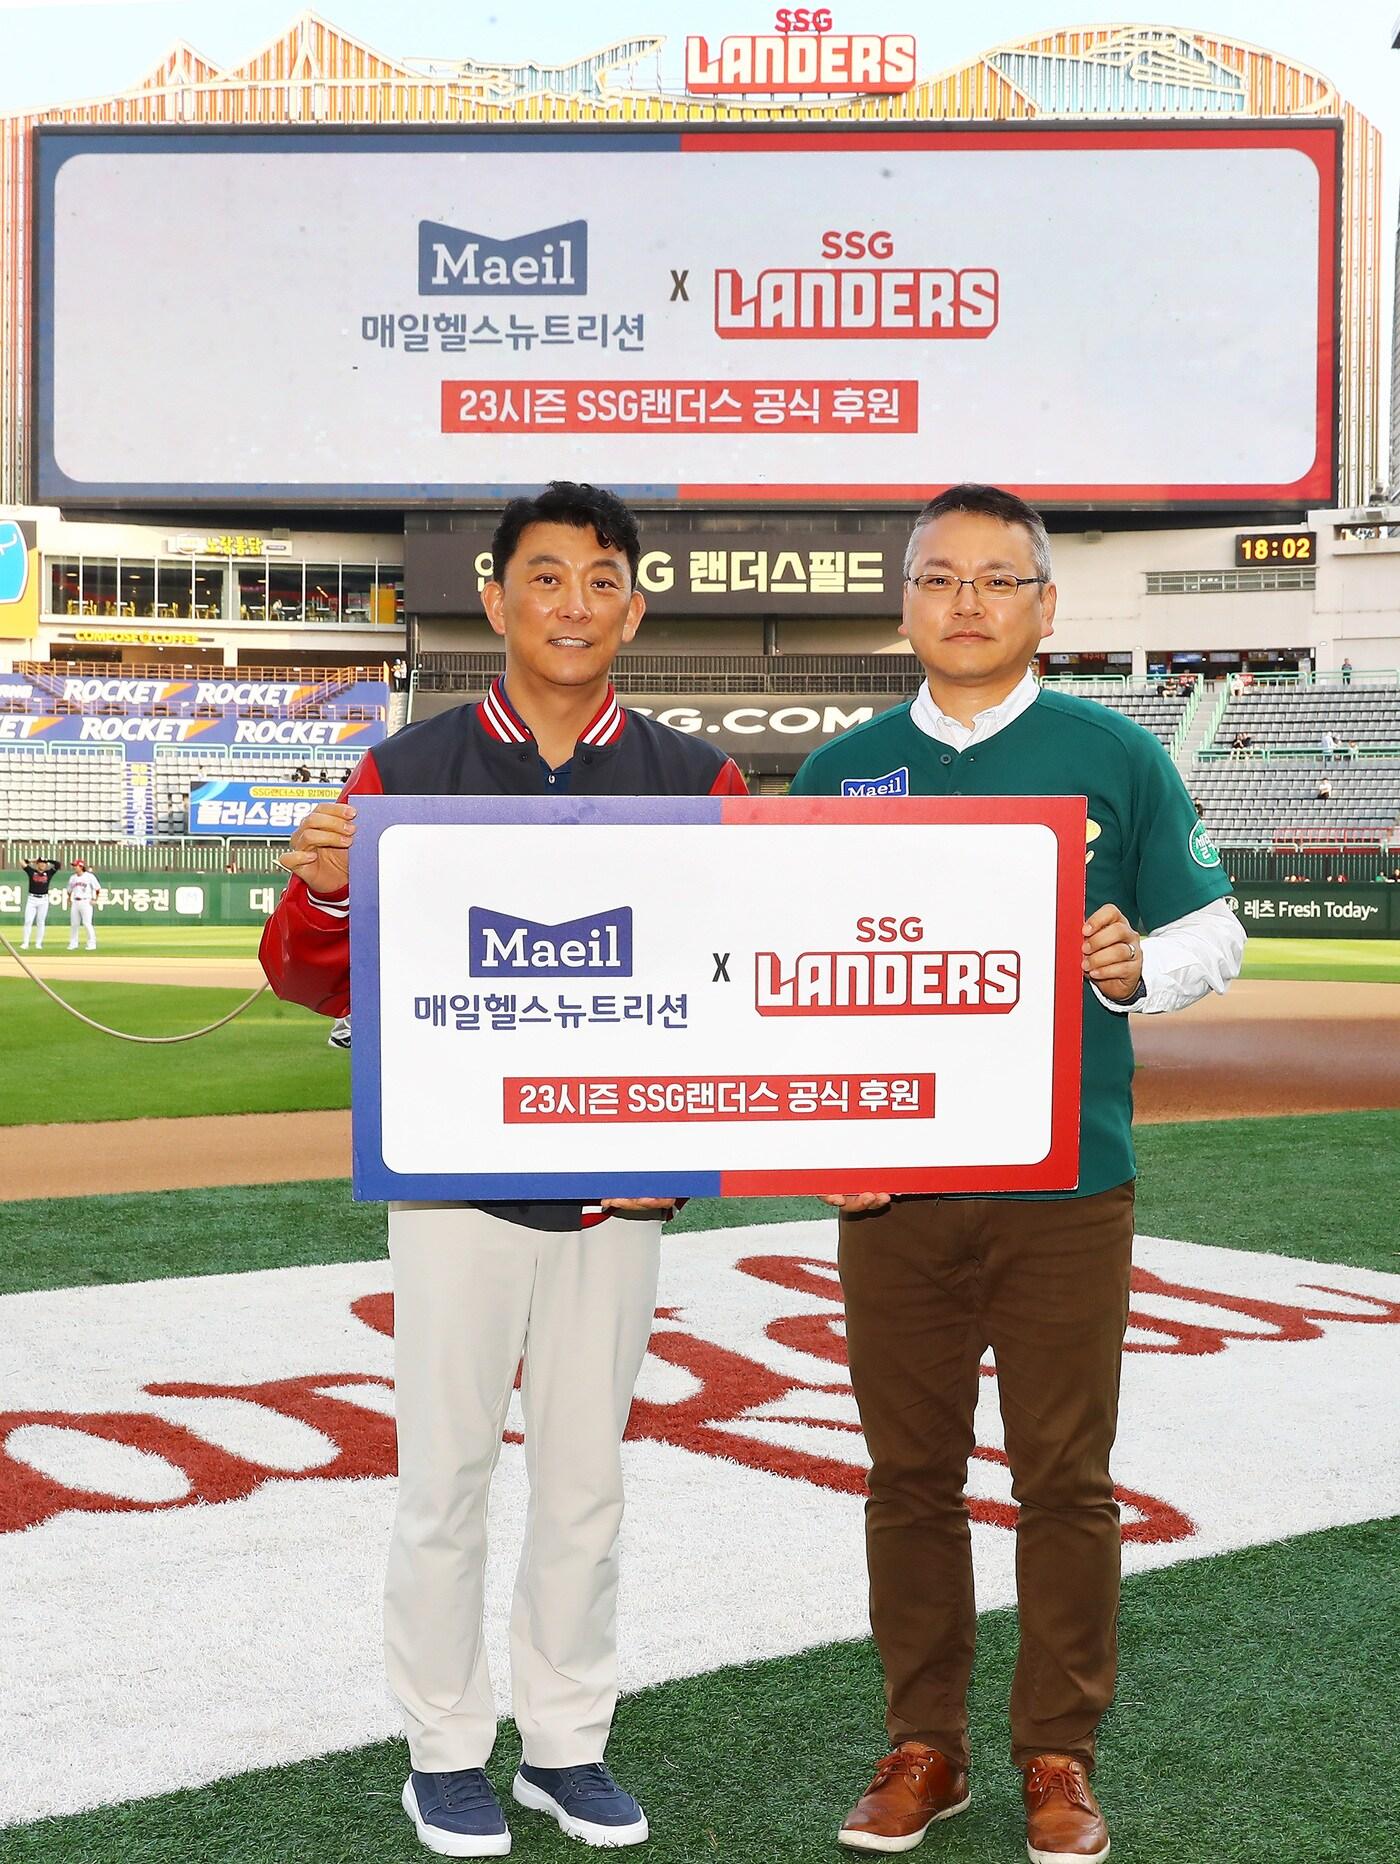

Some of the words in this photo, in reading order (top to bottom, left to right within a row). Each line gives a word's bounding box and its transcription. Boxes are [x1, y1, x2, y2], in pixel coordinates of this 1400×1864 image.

[774, 8, 833, 32] SSG
[686, 35, 916, 93] LANDERS
[821, 230, 894, 260] SSG
[431, 241, 575, 287] Maeil
[714, 267, 999, 339] LANDERS
[361, 312, 645, 353] 매일헬스뉴트리션
[459, 386, 567, 426] 23시즌
[577, 386, 743, 426] SSG랜더스
[752, 386, 821, 426] 공식
[832, 386, 901, 426] 후원
[1240, 536, 1311, 561] 18:02
[689, 550, 884, 594] 랜더스필드
[63, 679, 170, 703] ROCKET
[195, 683, 300, 706] ROCKET
[79, 717, 195, 742] ROCKET
[234, 720, 349, 745] ROCKET
[627, 706, 874, 735] G.COM
[848, 777, 902, 797] Maeil
[48, 887, 170, 912] 하투자증권
[1244, 899, 1275, 920] 레츠
[1279, 900, 1321, 919] Fresh
[1323, 901, 1379, 921] Today~
[856, 916, 924, 943] SSG
[480, 925, 622, 969] Maeil
[754, 950, 1021, 1017] LANDERS
[413, 992, 689, 1032] 매일헬스뉴트리션
[519, 1083, 620, 1117] 23시즌
[627, 1081, 780, 1116] SSG랜더스
[787, 1080, 850, 1115] 공식
[858, 1079, 921, 1114] 후원
